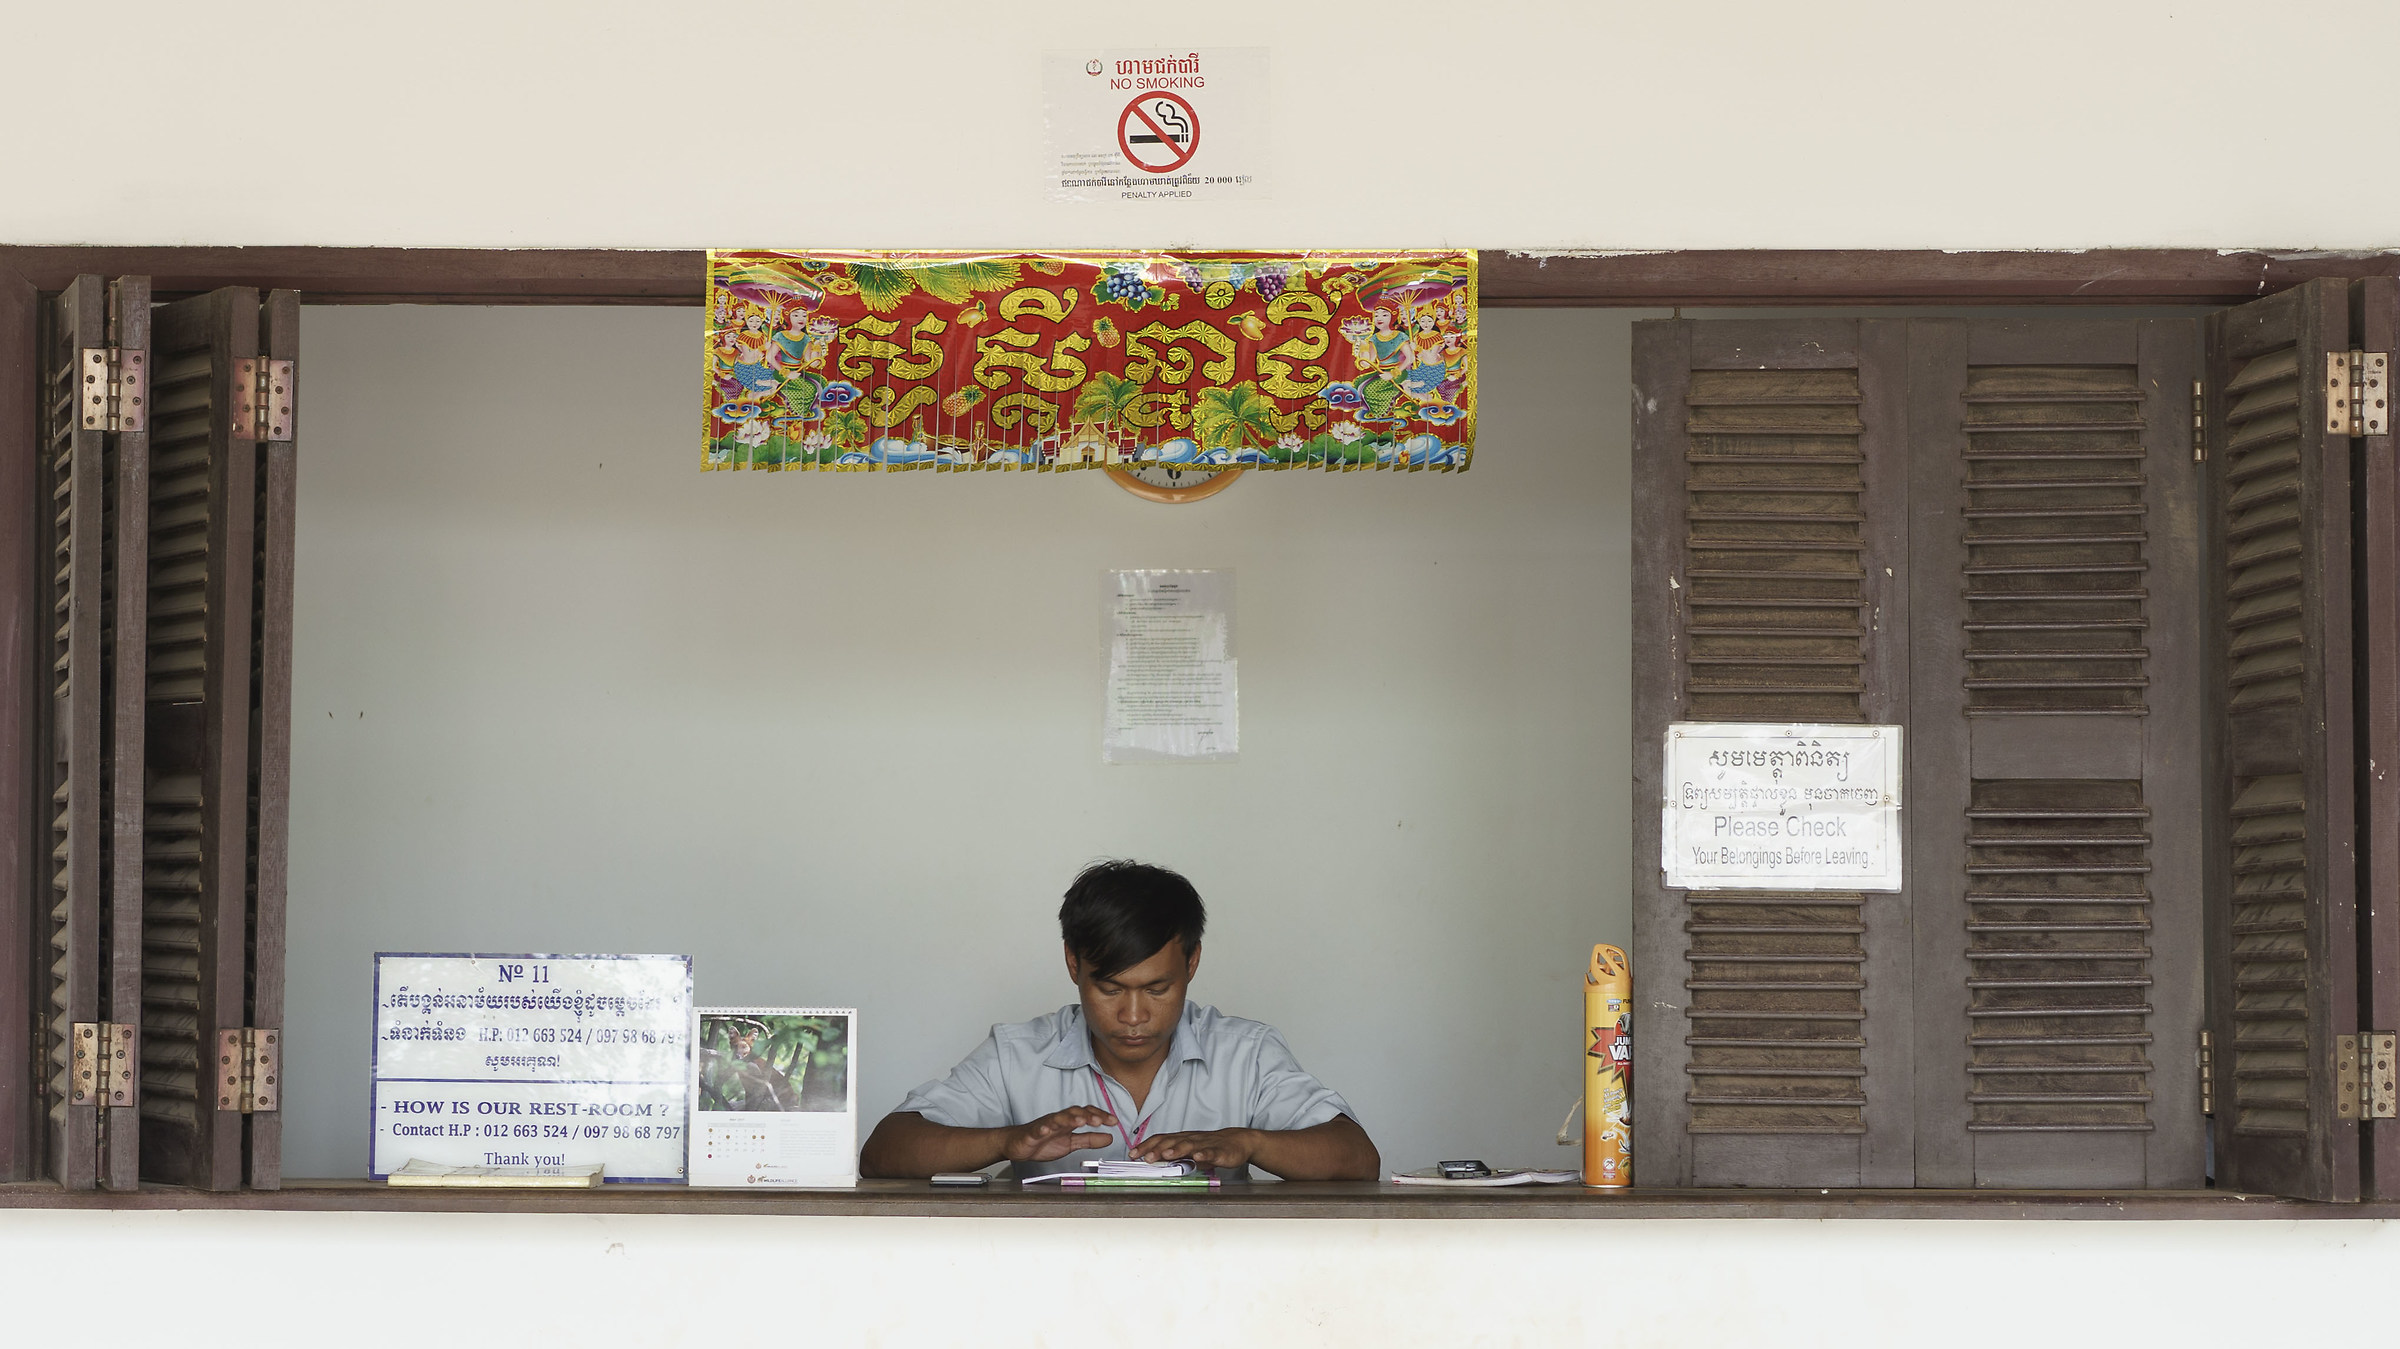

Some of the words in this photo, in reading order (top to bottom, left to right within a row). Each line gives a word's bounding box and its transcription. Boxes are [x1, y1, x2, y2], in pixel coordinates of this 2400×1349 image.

[1110, 78, 1132, 90] NO
[1136, 76, 1205, 89] SMOKING
[1205, 176, 1215, 184] 20
[1217, 176, 1233, 184] 000
[1121, 191, 1157, 199] PENALTY
[1158, 190, 1192, 198] APPLIED
[1714, 816, 1779, 837] Please
[1786, 815, 1847, 837] Check
[1692, 847, 1717, 865] Your
[1721, 847, 1782, 868] Belongings
[1785, 847, 1822, 865] Before
[532, 965, 549, 983] 11
[479, 1027, 502, 1042] H.P:
[507, 1028, 529, 1042] 012
[533, 1028, 555, 1043] 663
[560, 1028, 582, 1043] 524
[596, 1029, 619, 1043] 097
[623, 1029, 637, 1044] 98
[641, 1029, 656, 1044] 68
[661, 1030, 682, 1044] 79
[394, 1101, 444, 1114] HOW
[451, 1101, 470, 1115] IS
[477, 1102, 522, 1115] OUR
[529, 1103, 652, 1117] REST-ROOM
[392, 1123, 444, 1136] Contact
[484, 1124, 508, 1137] 012
[513, 1125, 538, 1137] 663
[543, 1125, 568, 1138] 524
[584, 1126, 609, 1139] 097
[613, 1126, 630, 1139] 98
[634, 1126, 651, 1139] 68
[656, 1126, 681, 1139] 797
[484, 1152, 529, 1165] Thank
[534, 1153, 565, 1168] you!
